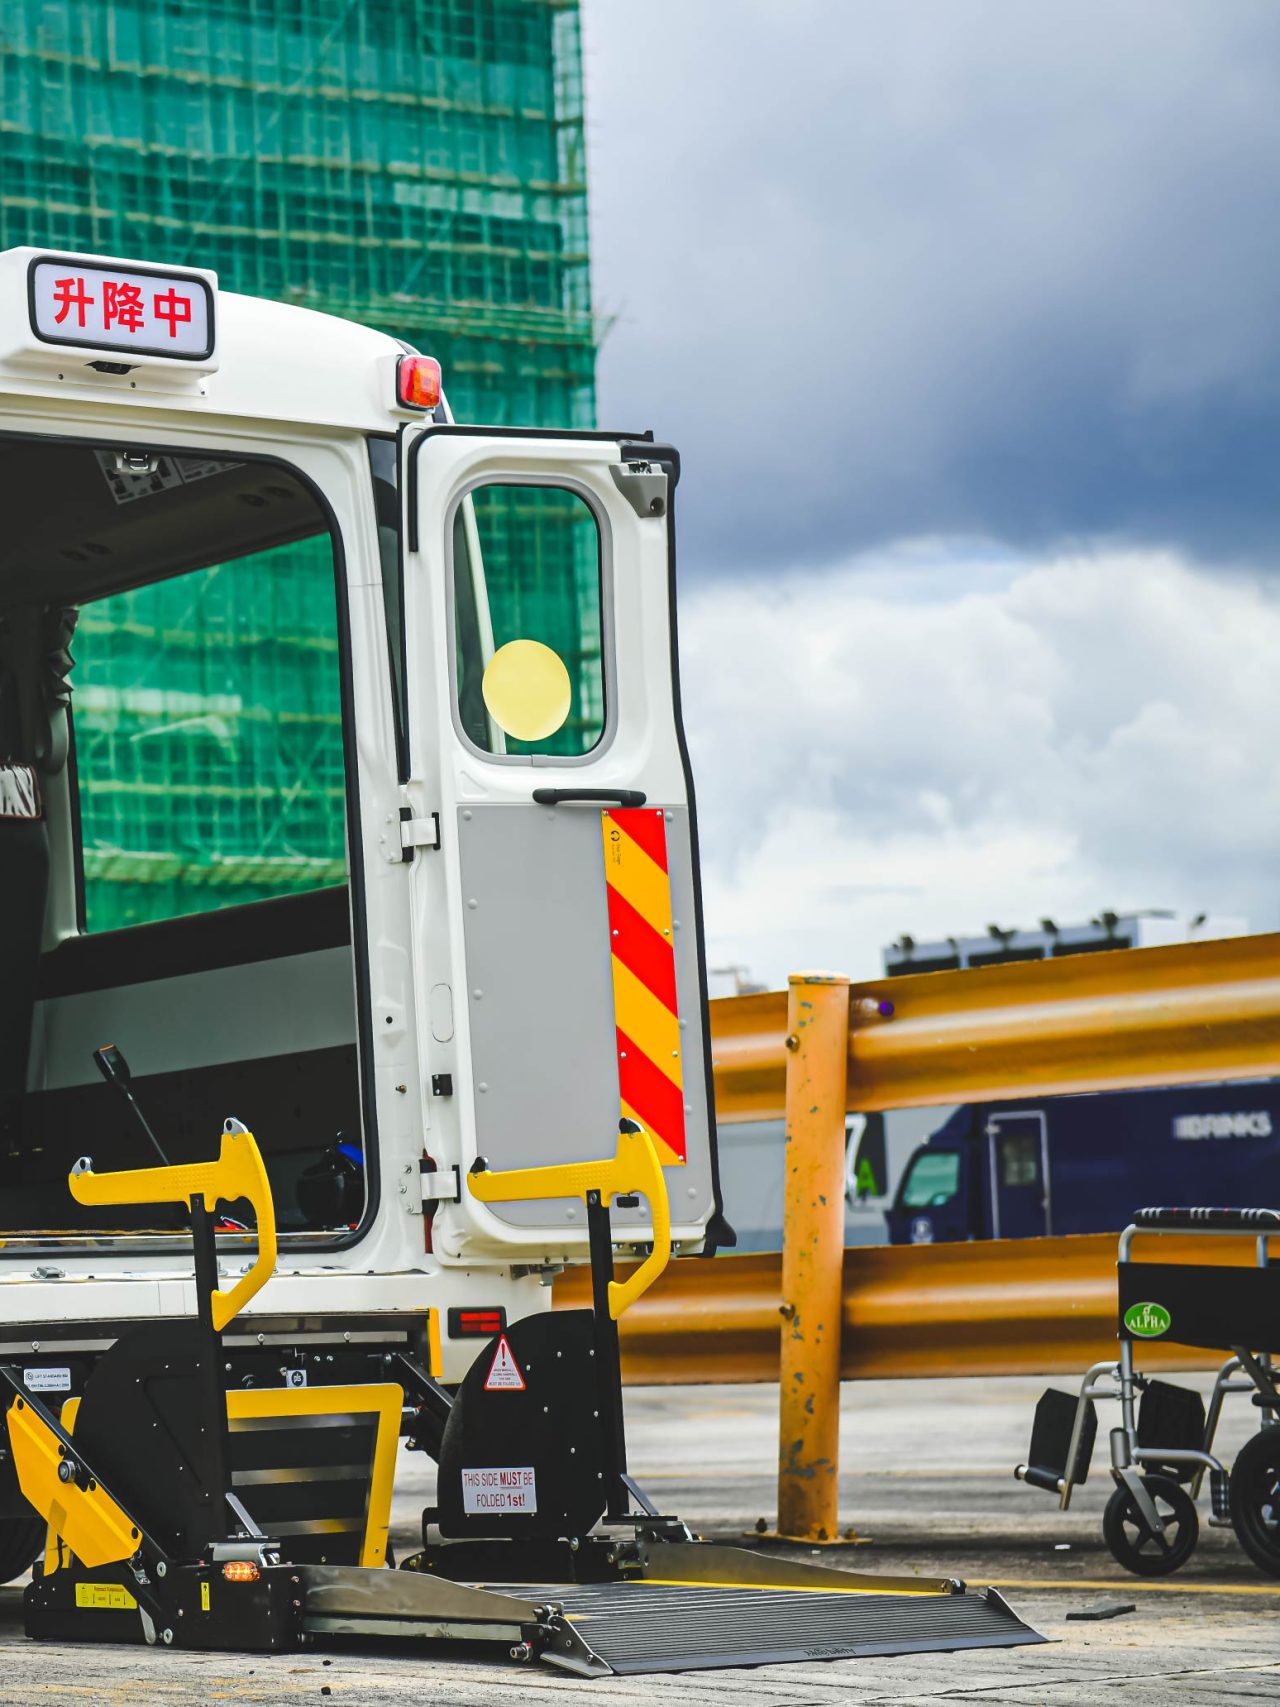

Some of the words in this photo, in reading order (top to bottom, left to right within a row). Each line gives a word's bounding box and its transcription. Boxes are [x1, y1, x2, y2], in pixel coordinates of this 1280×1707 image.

[53, 277, 192, 338] 升降中
[1129, 1314, 1167, 1328] ALPHA
[464, 1473, 480, 1486] THIS
[482, 1473, 498, 1486] SIDE
[500, 1471, 521, 1486] MUST
[524, 1472, 533, 1486] BE
[477, 1494, 505, 1507] FOLDED
[507, 1493, 525, 1506] 1st!
